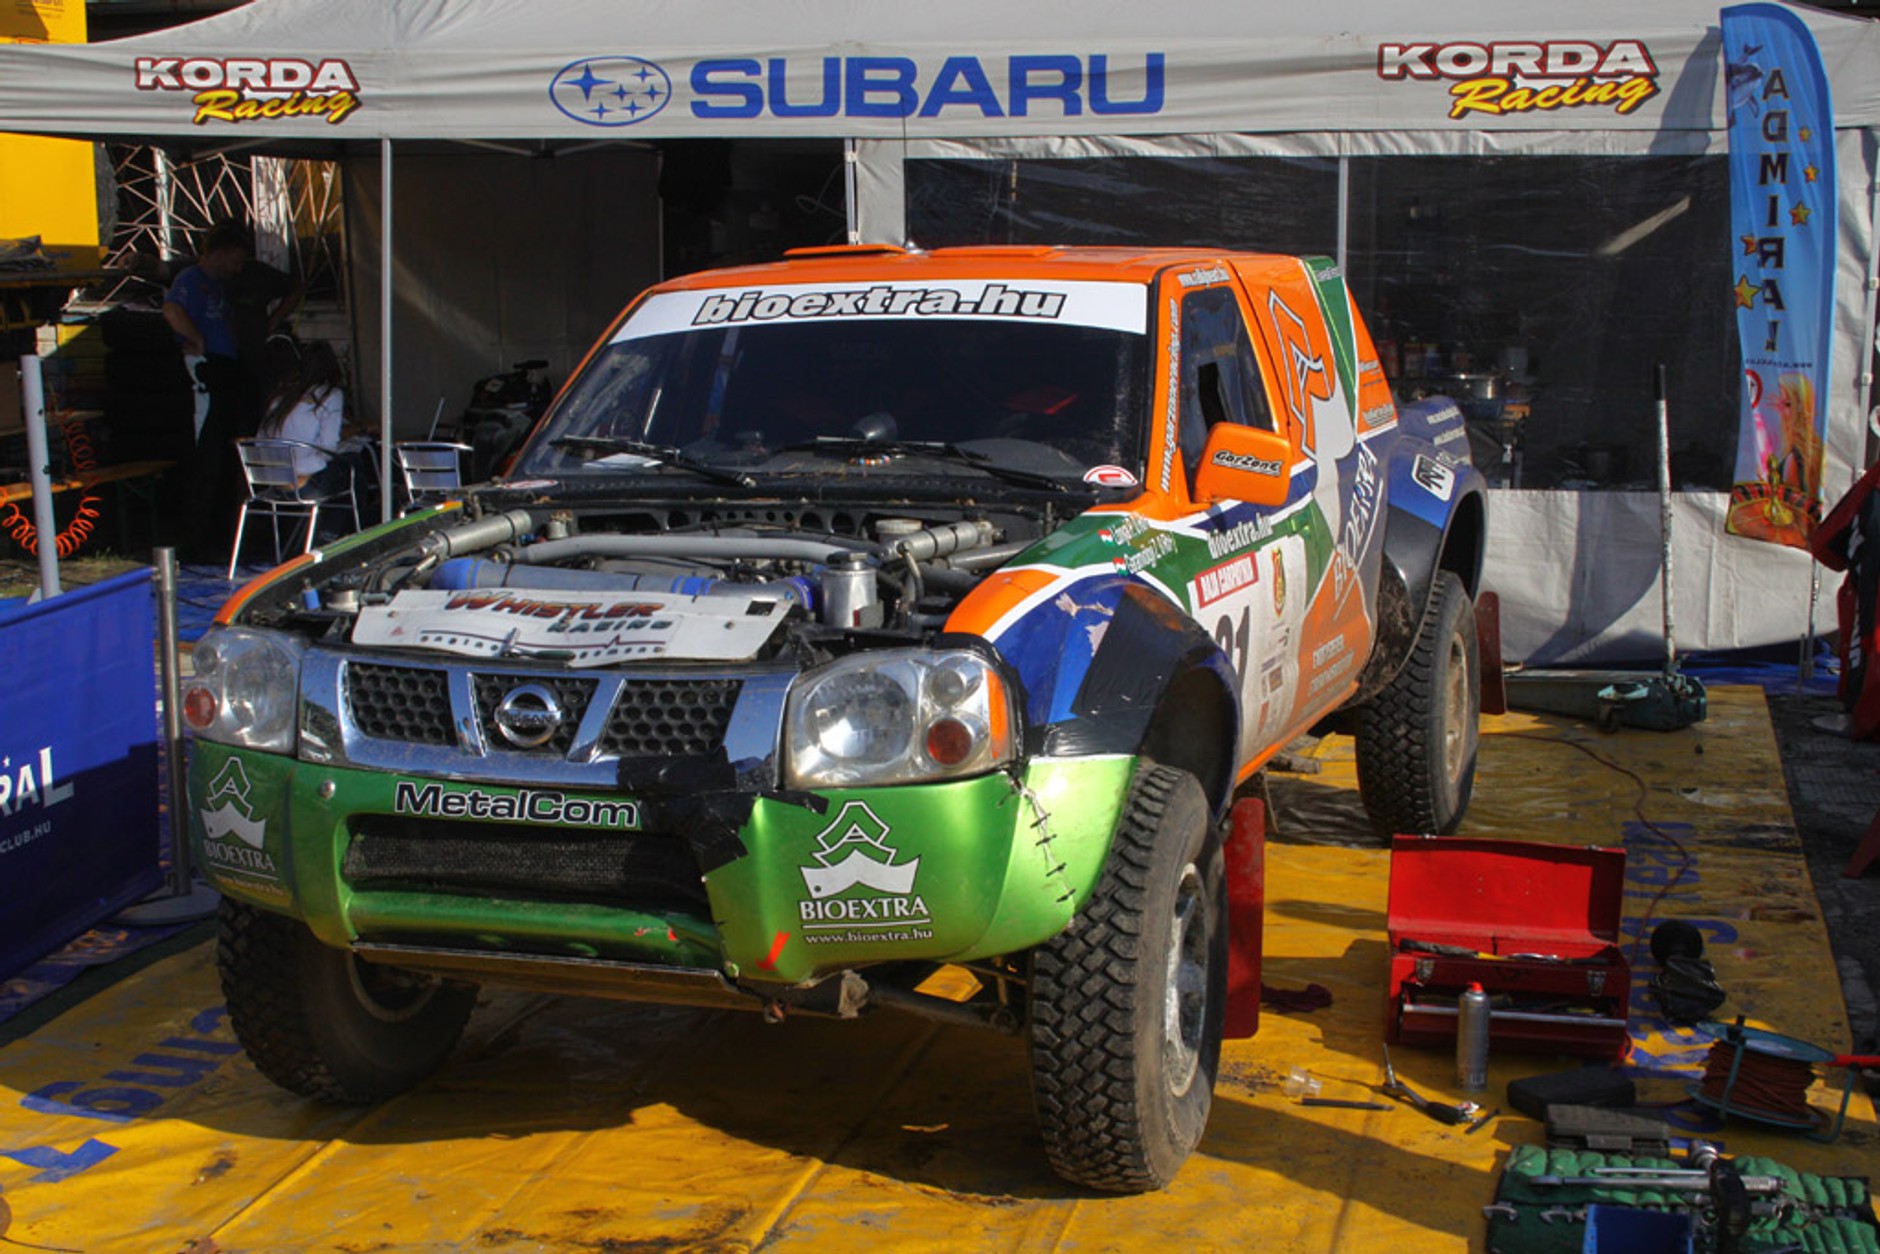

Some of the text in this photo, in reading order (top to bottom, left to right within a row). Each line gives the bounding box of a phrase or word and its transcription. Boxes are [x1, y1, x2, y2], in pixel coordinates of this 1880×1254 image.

[134, 56, 360, 92] KORDA
[1377, 39, 1660, 83] KORDA
[191, 87, 363, 126] Racing
[690, 52, 1165, 119] SUBARU
[1448, 72, 1661, 119] Racing
[691, 284, 1067, 326] bioextra.hu
[1207, 513, 1273, 559] bioextra.hu
[396, 782, 637, 828] MetalCom
[204, 839, 277, 871] BIOEXTRA
[800, 897, 928, 919] BIOEXTRA
[805, 929, 932, 943] www.bioextra.hu
